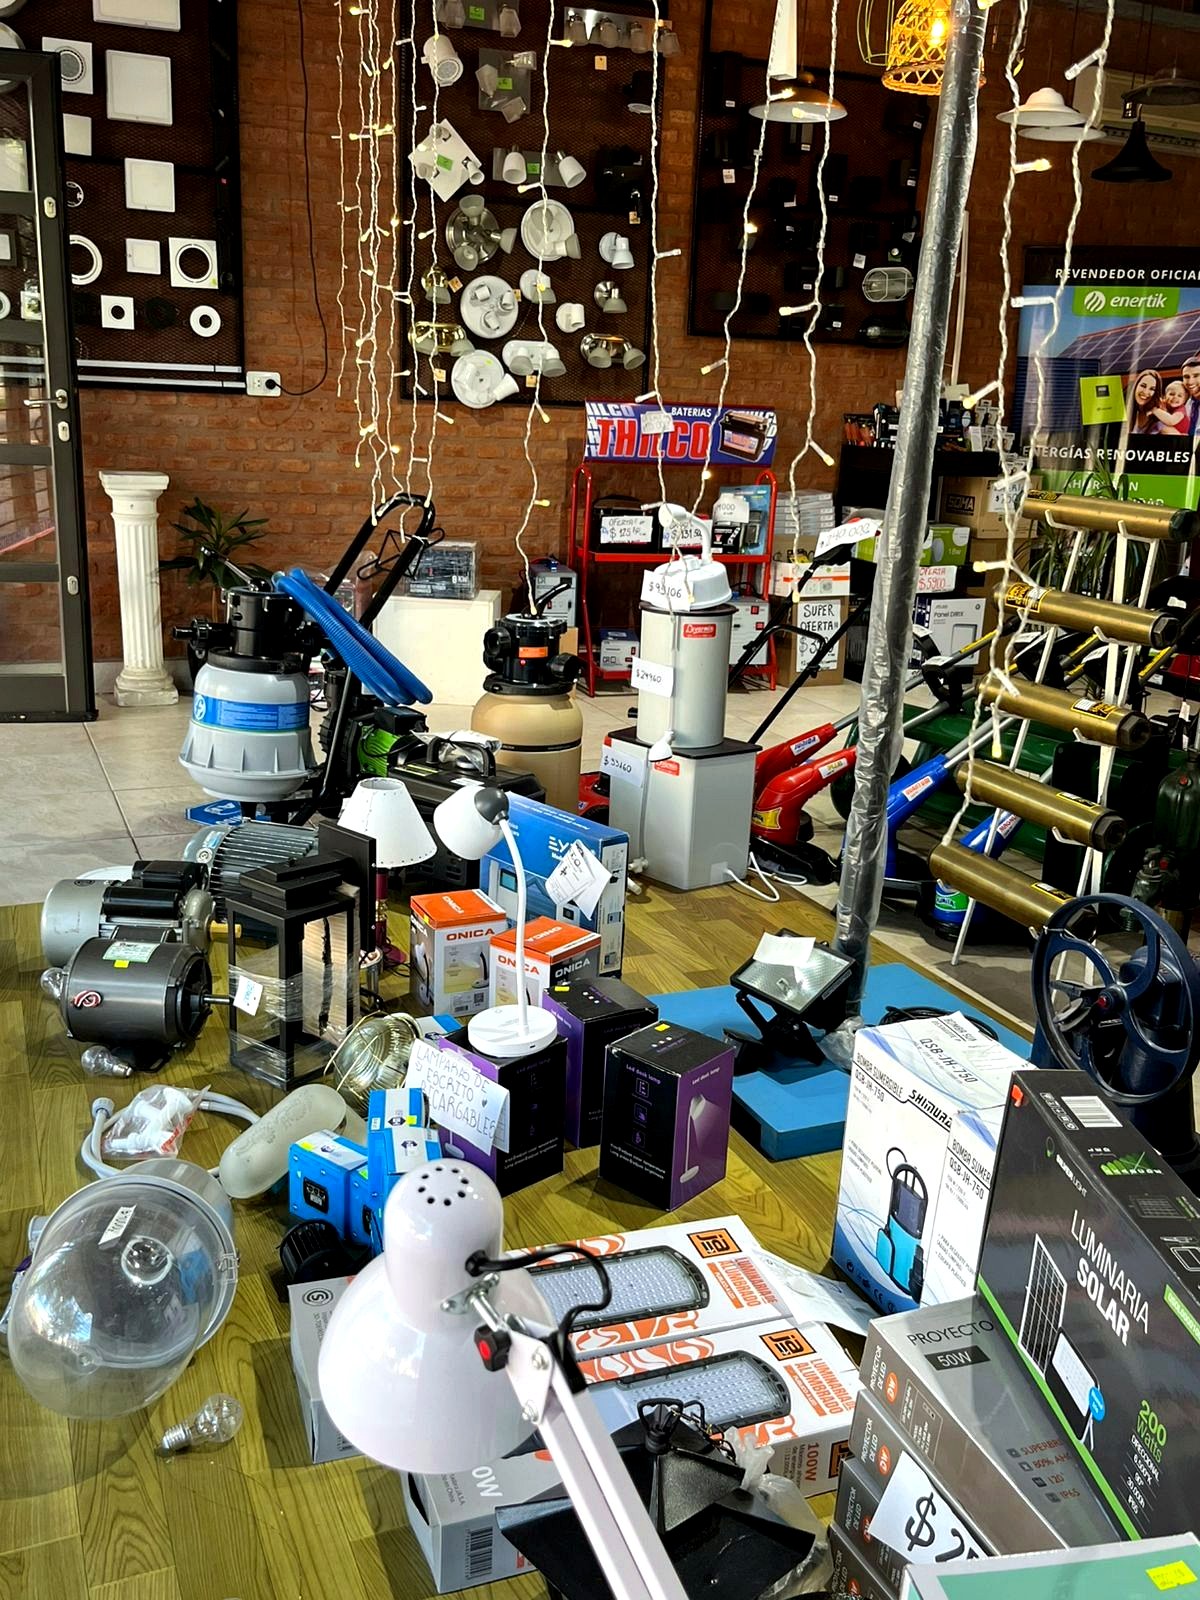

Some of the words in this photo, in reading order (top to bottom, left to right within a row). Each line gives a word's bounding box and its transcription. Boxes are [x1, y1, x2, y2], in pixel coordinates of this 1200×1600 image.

[1055, 268, 1145, 279] REVENDEDOR
[1110, 293, 1167, 308] enertik
[671, 407, 712, 418] BATERIAS
[1023, 444, 1092, 459] ENERGÍAS
[1096, 448, 1190, 463] RENOVABLES
[804, 604, 835, 617] SUPER
[446, 927, 496, 942] ONICA
[498, 954, 540, 976] ONCA
[554, 957, 591, 979] ONICA
[474, 1072, 490, 1094] DE
[952, 1139, 971, 1165] BOMBA
[718, 1260, 761, 1307] ALUMBRADO
[1071, 1209, 1148, 1334] LUMINARIA
[1076, 1257, 1129, 1347] SOLAR
[906, 1319, 994, 1346] PROYECTO
[870, 1345, 882, 1391] PROYECTOR
[879, 1362, 887, 1379] LED
[937, 1353, 972, 1367] 50W
[795, 1362, 844, 1414] ALUMBRADO
[810, 1358, 851, 1408] LUMINARIA
[877, 1378, 883, 1390] DE
[1140, 1400, 1166, 1447] 200
[861, 1418, 873, 1463] PROYECTOR
[1136, 1415, 1162, 1463] Watts
[805, 1442, 819, 1482] 100W
[471, 1465, 503, 1499] 0W
[905, 1492, 980, 1564] $2
